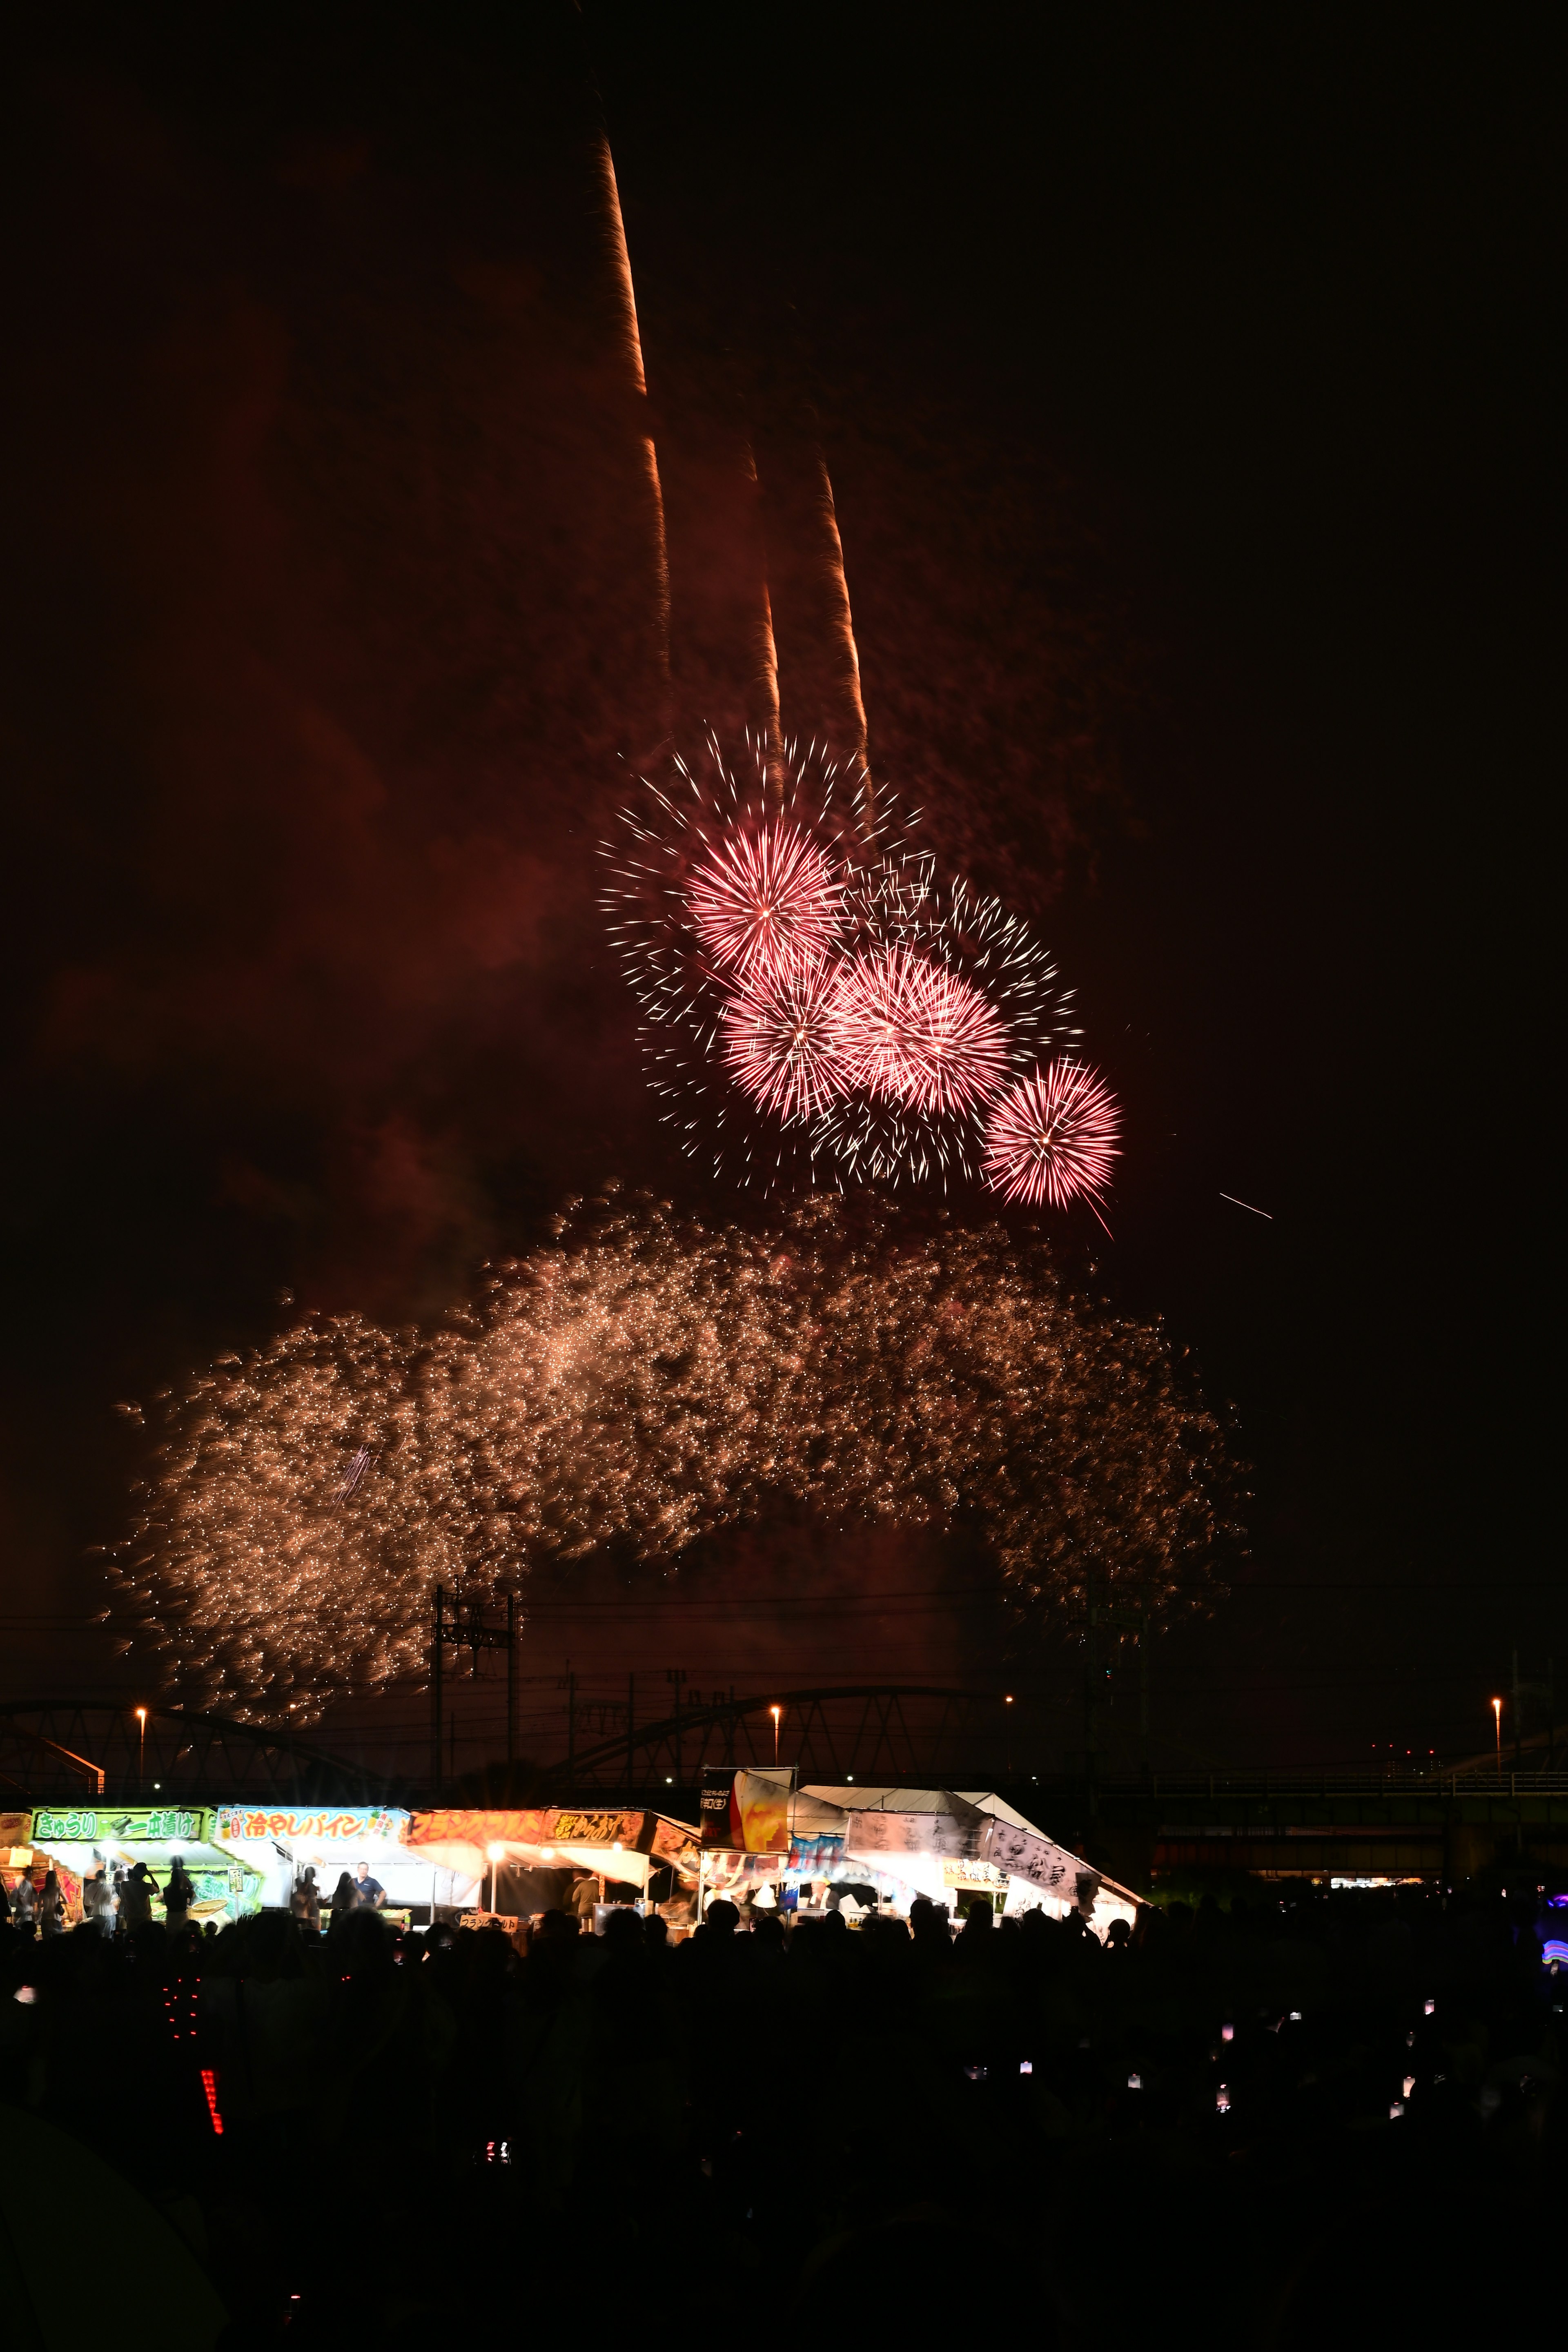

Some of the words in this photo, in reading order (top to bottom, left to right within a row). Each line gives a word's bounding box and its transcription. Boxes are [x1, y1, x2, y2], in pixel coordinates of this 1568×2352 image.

[40, 1813, 96, 1837] きゅうり
[127, 1812, 193, 1837] 一本漬け
[245, 1812, 364, 1838] 冷やしパイン
